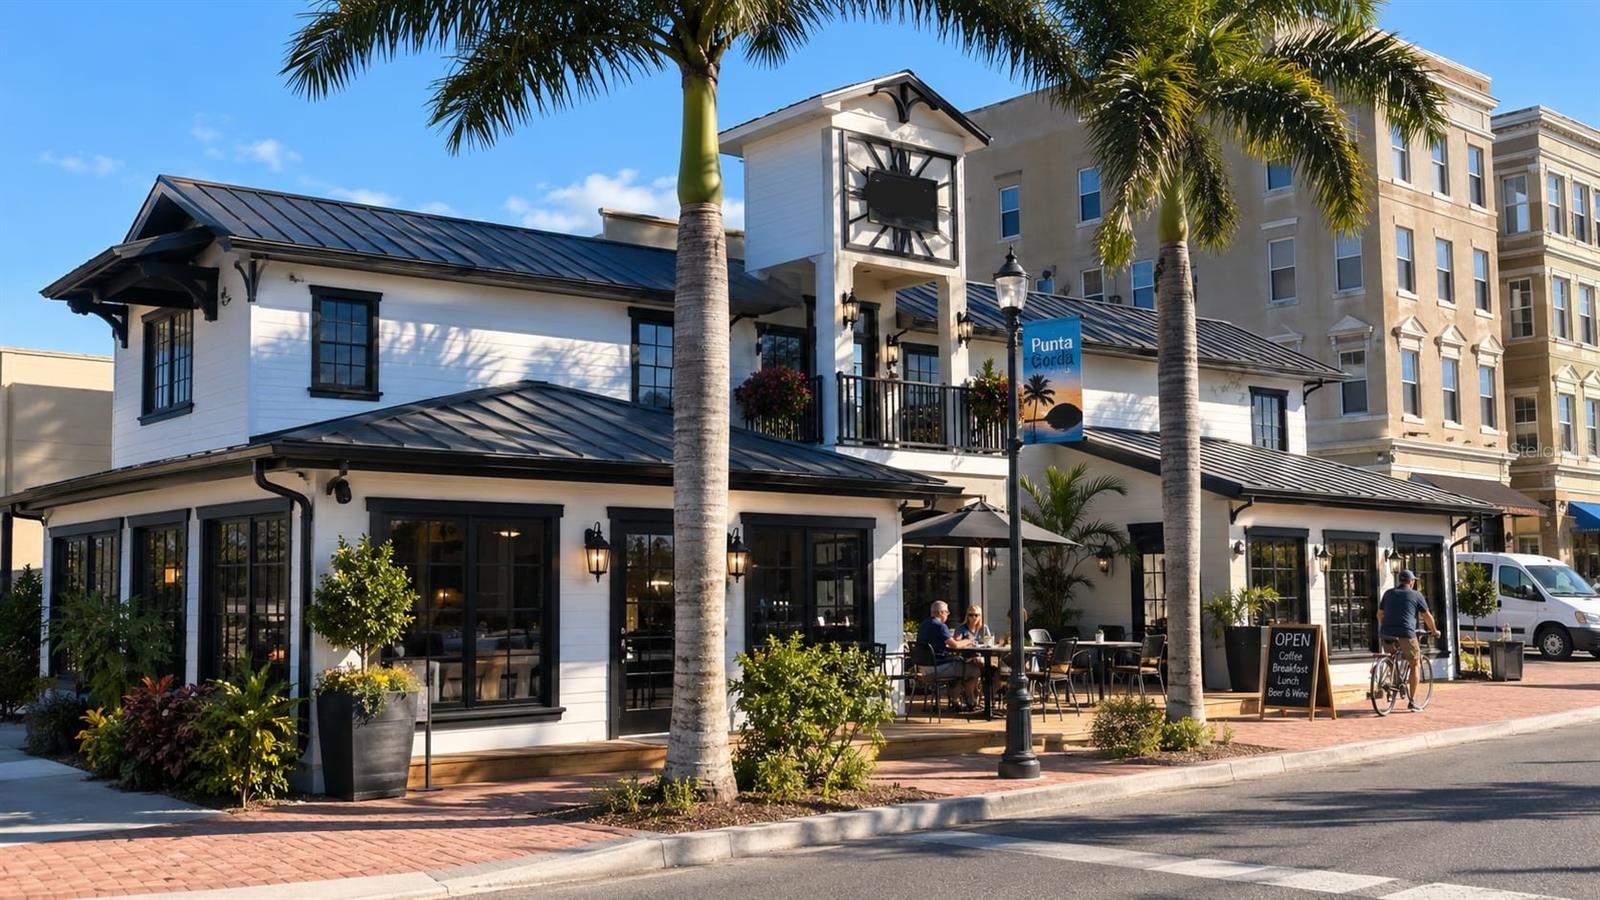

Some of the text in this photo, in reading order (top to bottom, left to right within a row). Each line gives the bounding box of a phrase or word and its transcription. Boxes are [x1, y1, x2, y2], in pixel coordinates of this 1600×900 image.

[1032, 336, 1073, 353] Punta
[1275, 632, 1311, 647] OPEN
[1279, 651, 1303, 661] Coffee
[1272, 662, 1308, 674] Breakfast
[1277, 676, 1300, 685] Lunch
[1268, 687, 1309, 698] Beer & Wine
